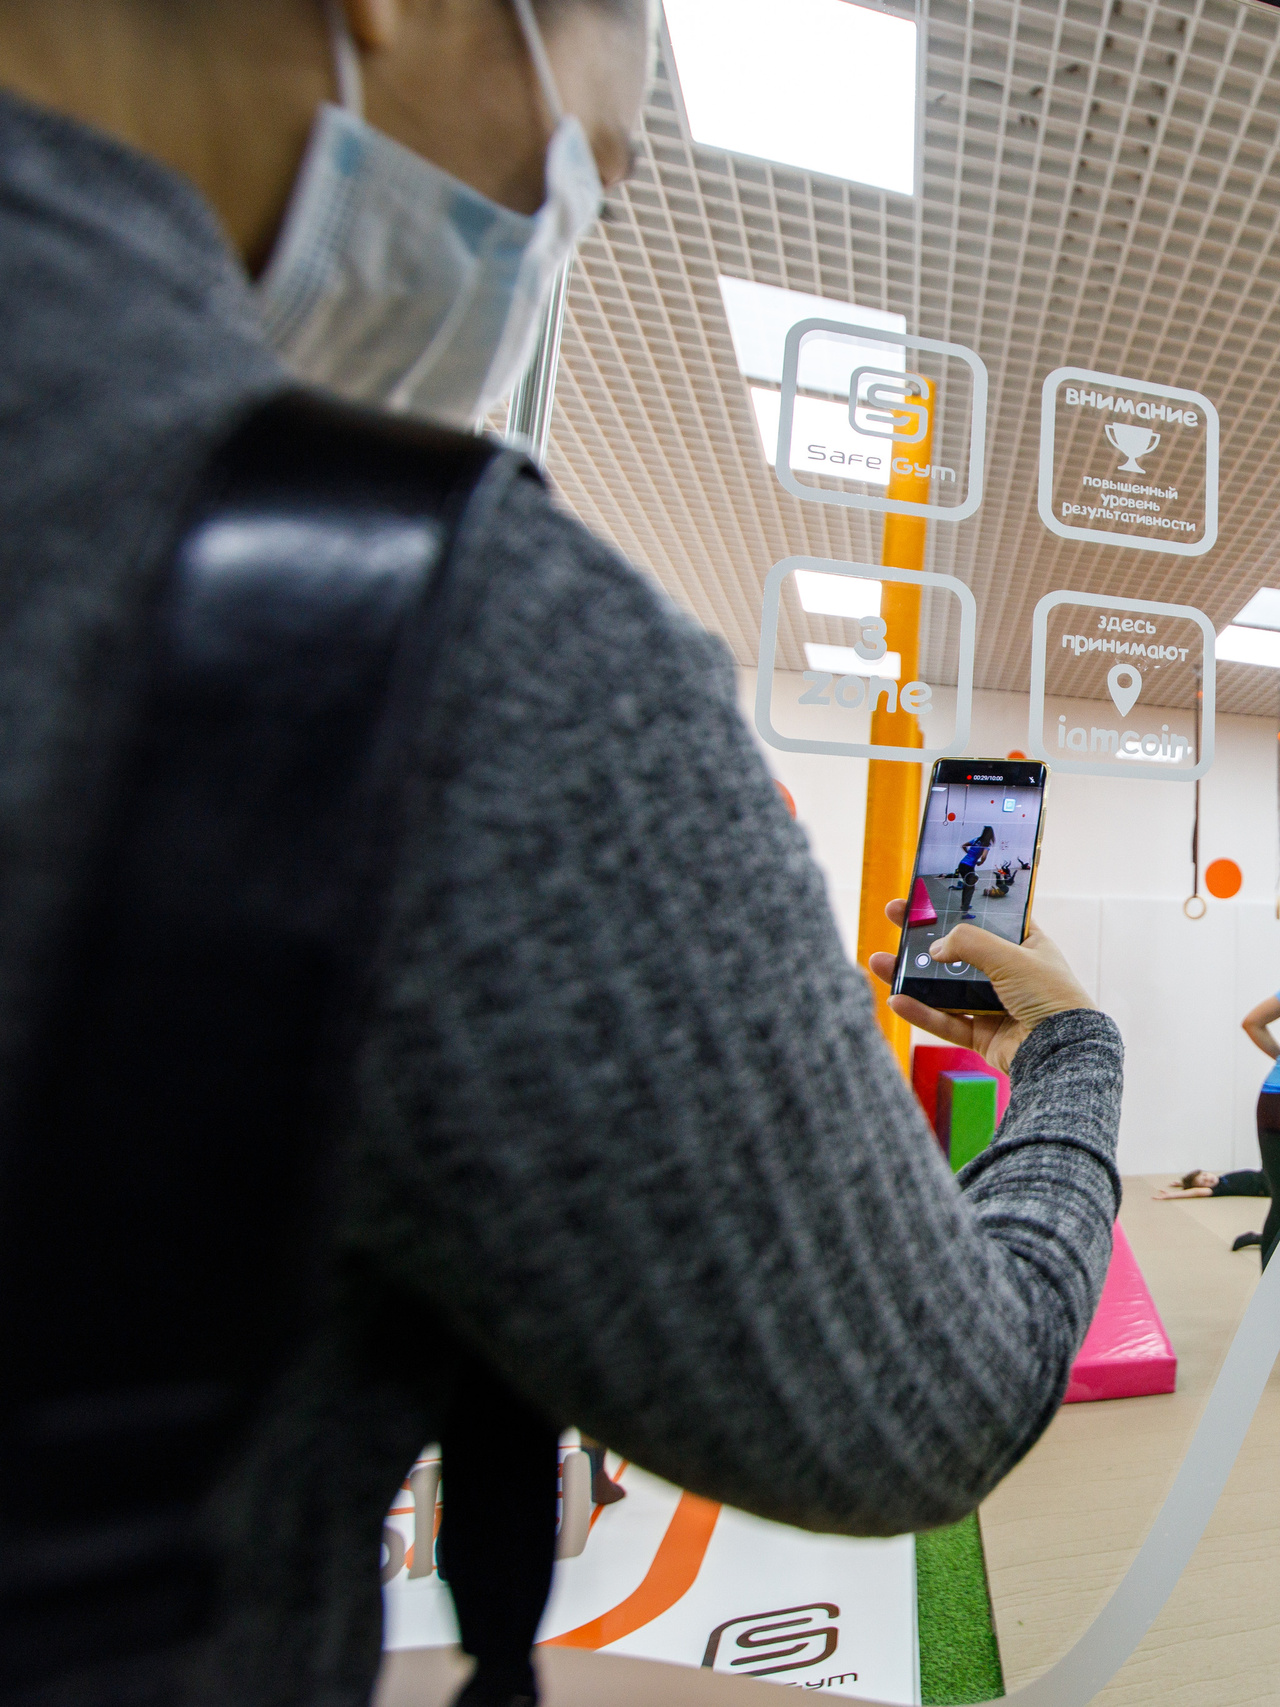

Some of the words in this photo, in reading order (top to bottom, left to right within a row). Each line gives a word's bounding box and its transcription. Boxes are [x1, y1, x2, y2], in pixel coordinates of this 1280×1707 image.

[892, 457, 956, 482] Gym
[1083, 476, 1178, 499] повышенный
[1101, 494, 1160, 511] уровень
[1062, 502, 1196, 531] результативности
[1098, 615, 1157, 634] здесь
[854, 616, 887, 660] 3
[1062, 635, 1189, 661] принимают
[798, 671, 933, 714] zone
[1058, 715, 1189, 758] iamcoin
